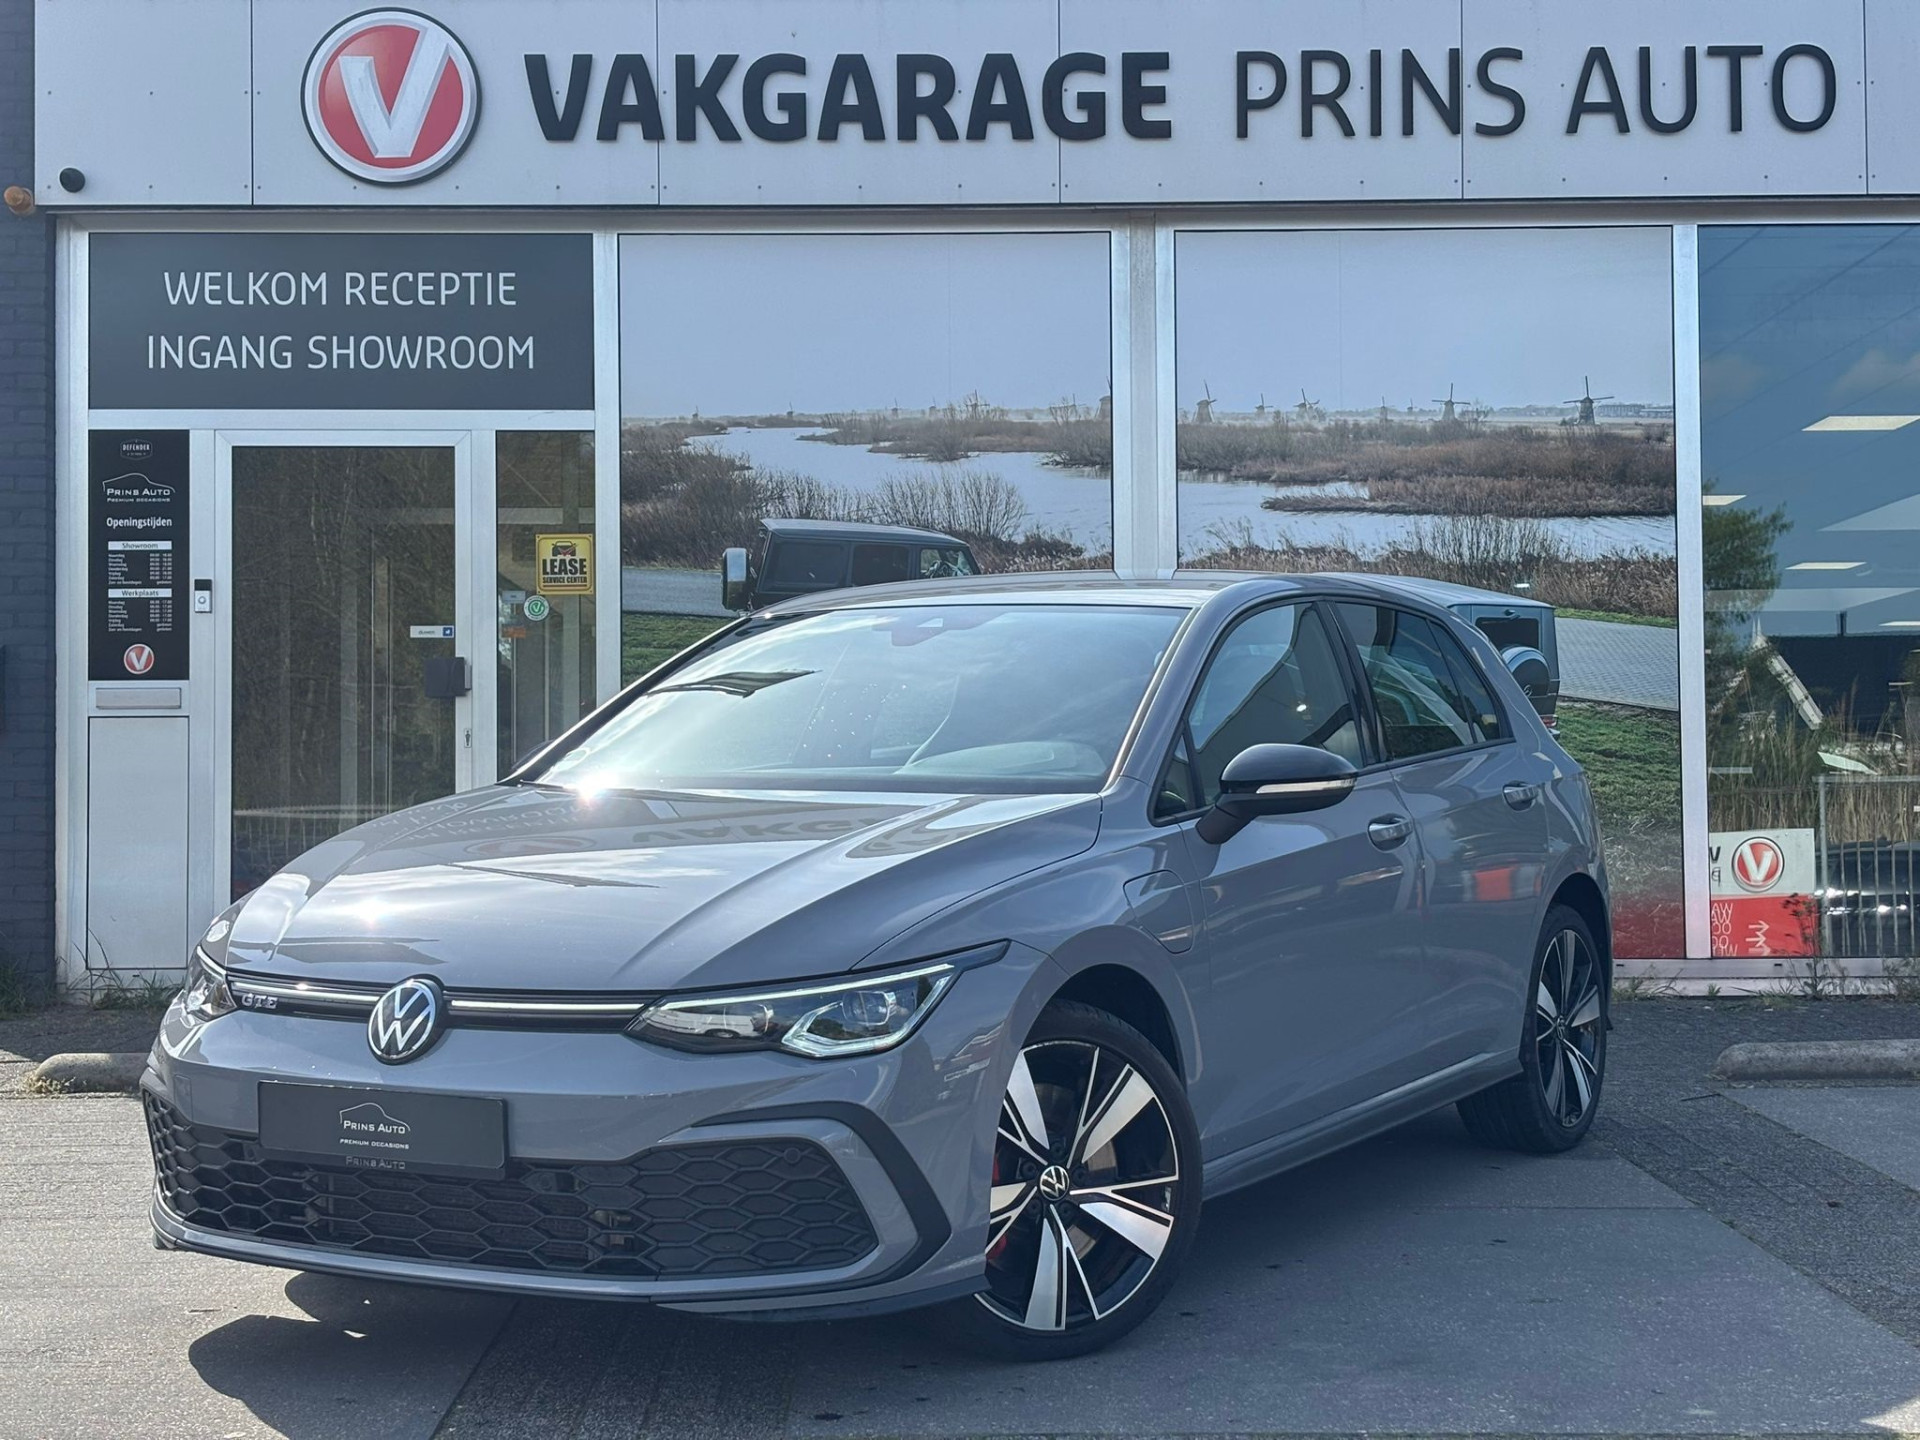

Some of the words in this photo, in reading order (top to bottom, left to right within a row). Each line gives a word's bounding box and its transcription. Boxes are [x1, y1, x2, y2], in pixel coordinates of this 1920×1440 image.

[339, 23, 449, 158] V
[524, 52, 1172, 141] VAKGARAGE
[1236, 47, 1526, 138] PRINS
[1565, 44, 1837, 135] AUTO
[164, 272, 327, 306] WELKOM
[345, 272, 517, 306] RECEPTIE
[148, 335, 292, 370] INGANG
[307, 335, 534, 369] SHOWROOM
[106, 488, 140, 496] PRINS
[142, 488, 171, 496] AUTO
[106, 517, 172, 529] Openingstijden
[542, 558, 587, 575] LEASE
[542, 576, 565, 584] SERVICE
[566, 576, 587, 584] CENTER
[121, 589, 159, 598] Werkplaats
[241, 993, 279, 1010] GTE
[343, 1120, 375, 1132] PRINS
[377, 1123, 406, 1134] AUTO
[340, 1138, 370, 1146] PREMIUM
[371, 1141, 410, 1150] OCCASIONS
[345, 1156, 377, 1167] PRINS
[378, 1158, 406, 1170] AUTO
